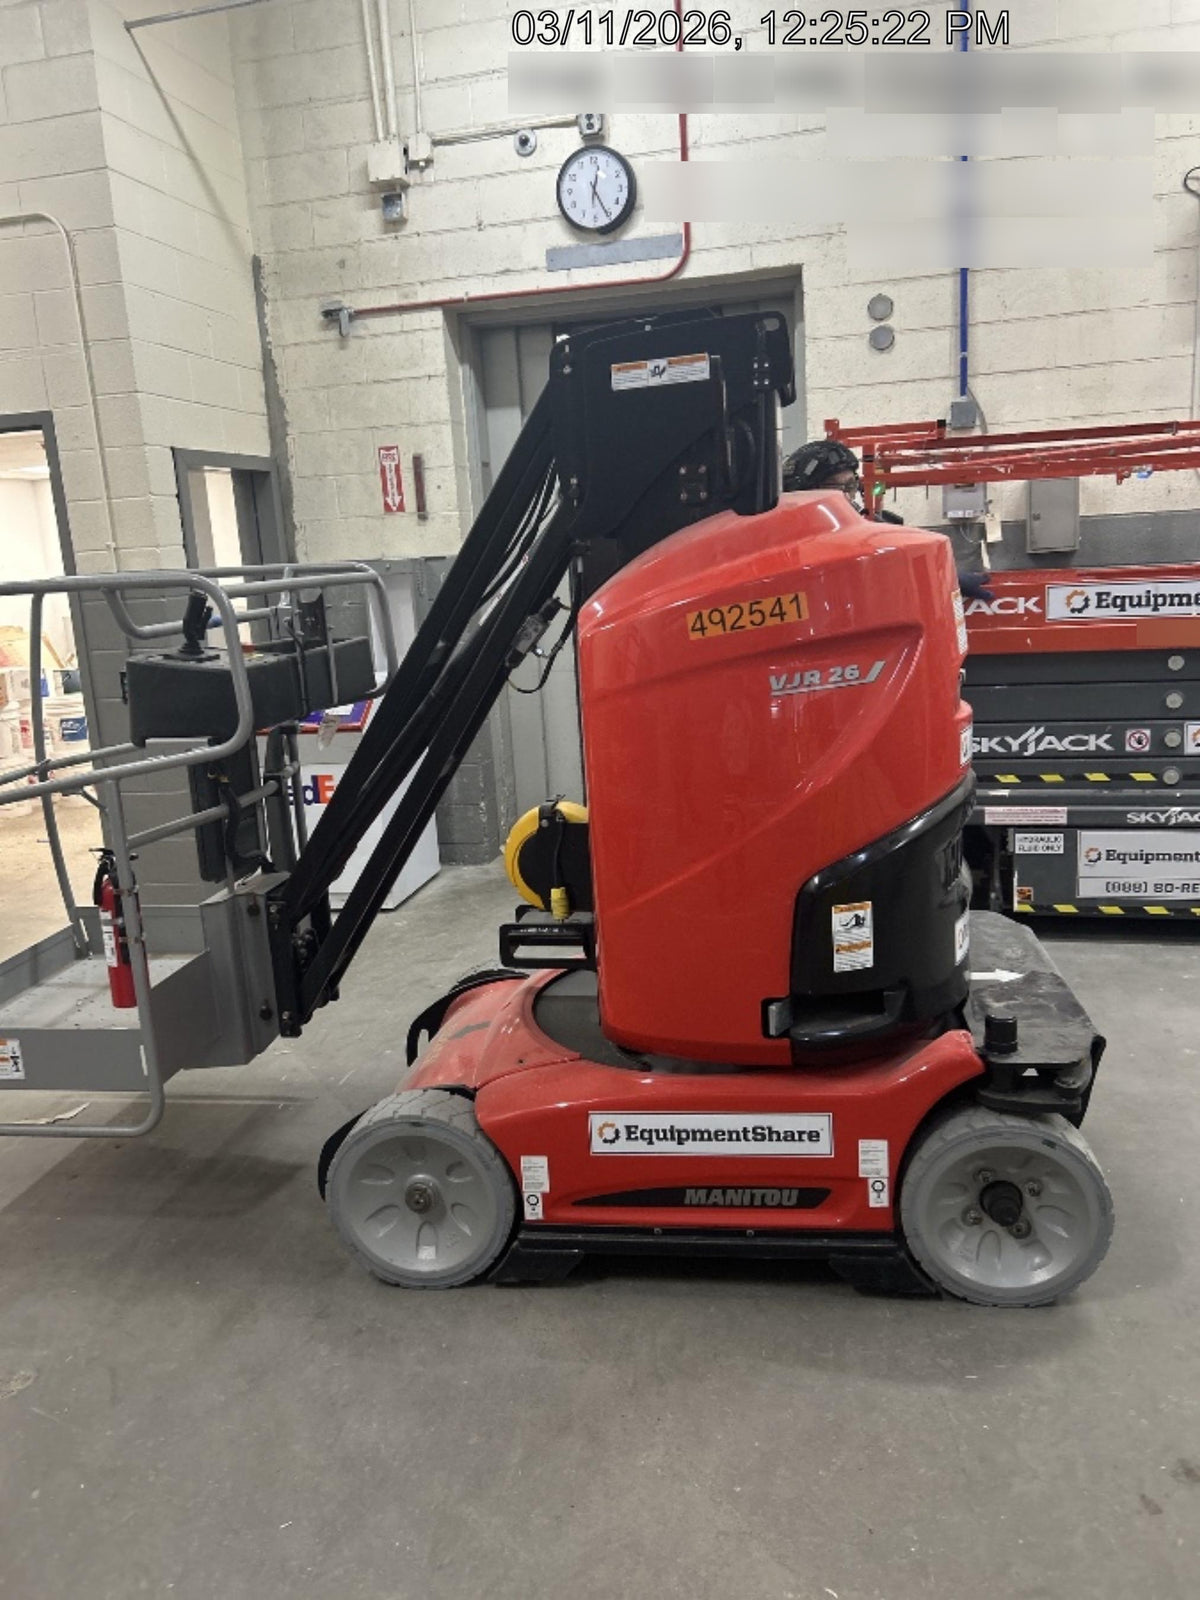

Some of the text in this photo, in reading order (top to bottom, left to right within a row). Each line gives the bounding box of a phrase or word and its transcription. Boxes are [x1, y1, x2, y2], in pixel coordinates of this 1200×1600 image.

[589, 156, 598, 165] 12
[690, 593, 804, 637] 492541
[769, 664, 860, 691] VJR 26
[625, 1125, 821, 1146] EquipmentShare
[684, 1188, 799, 1206] MANITOU
